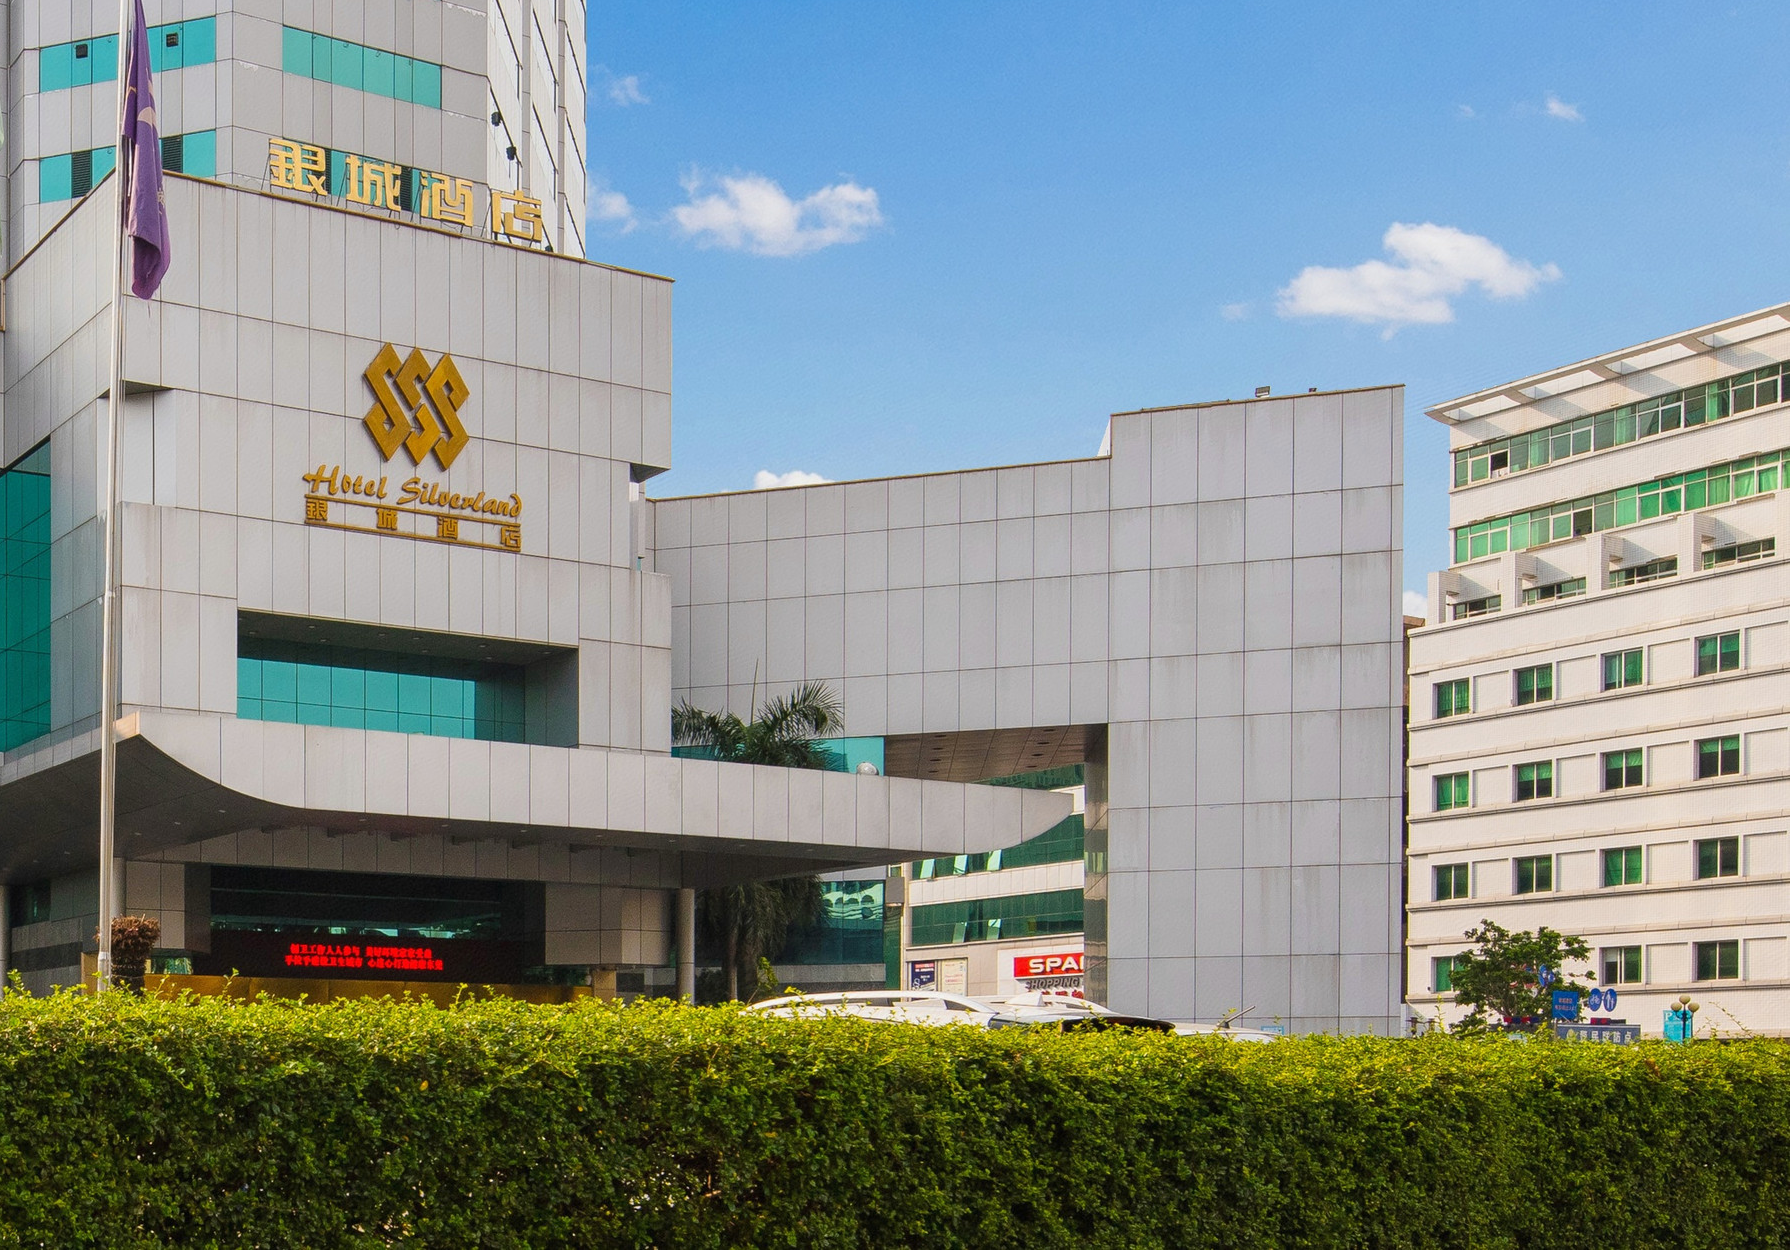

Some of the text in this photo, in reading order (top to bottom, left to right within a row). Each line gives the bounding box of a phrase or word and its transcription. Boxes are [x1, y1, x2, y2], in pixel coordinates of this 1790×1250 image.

[268, 138, 542, 243] 銀城酒店
[302, 464, 523, 518] Hotel Silverland
[1025, 977, 1080, 991] SHOPPING
